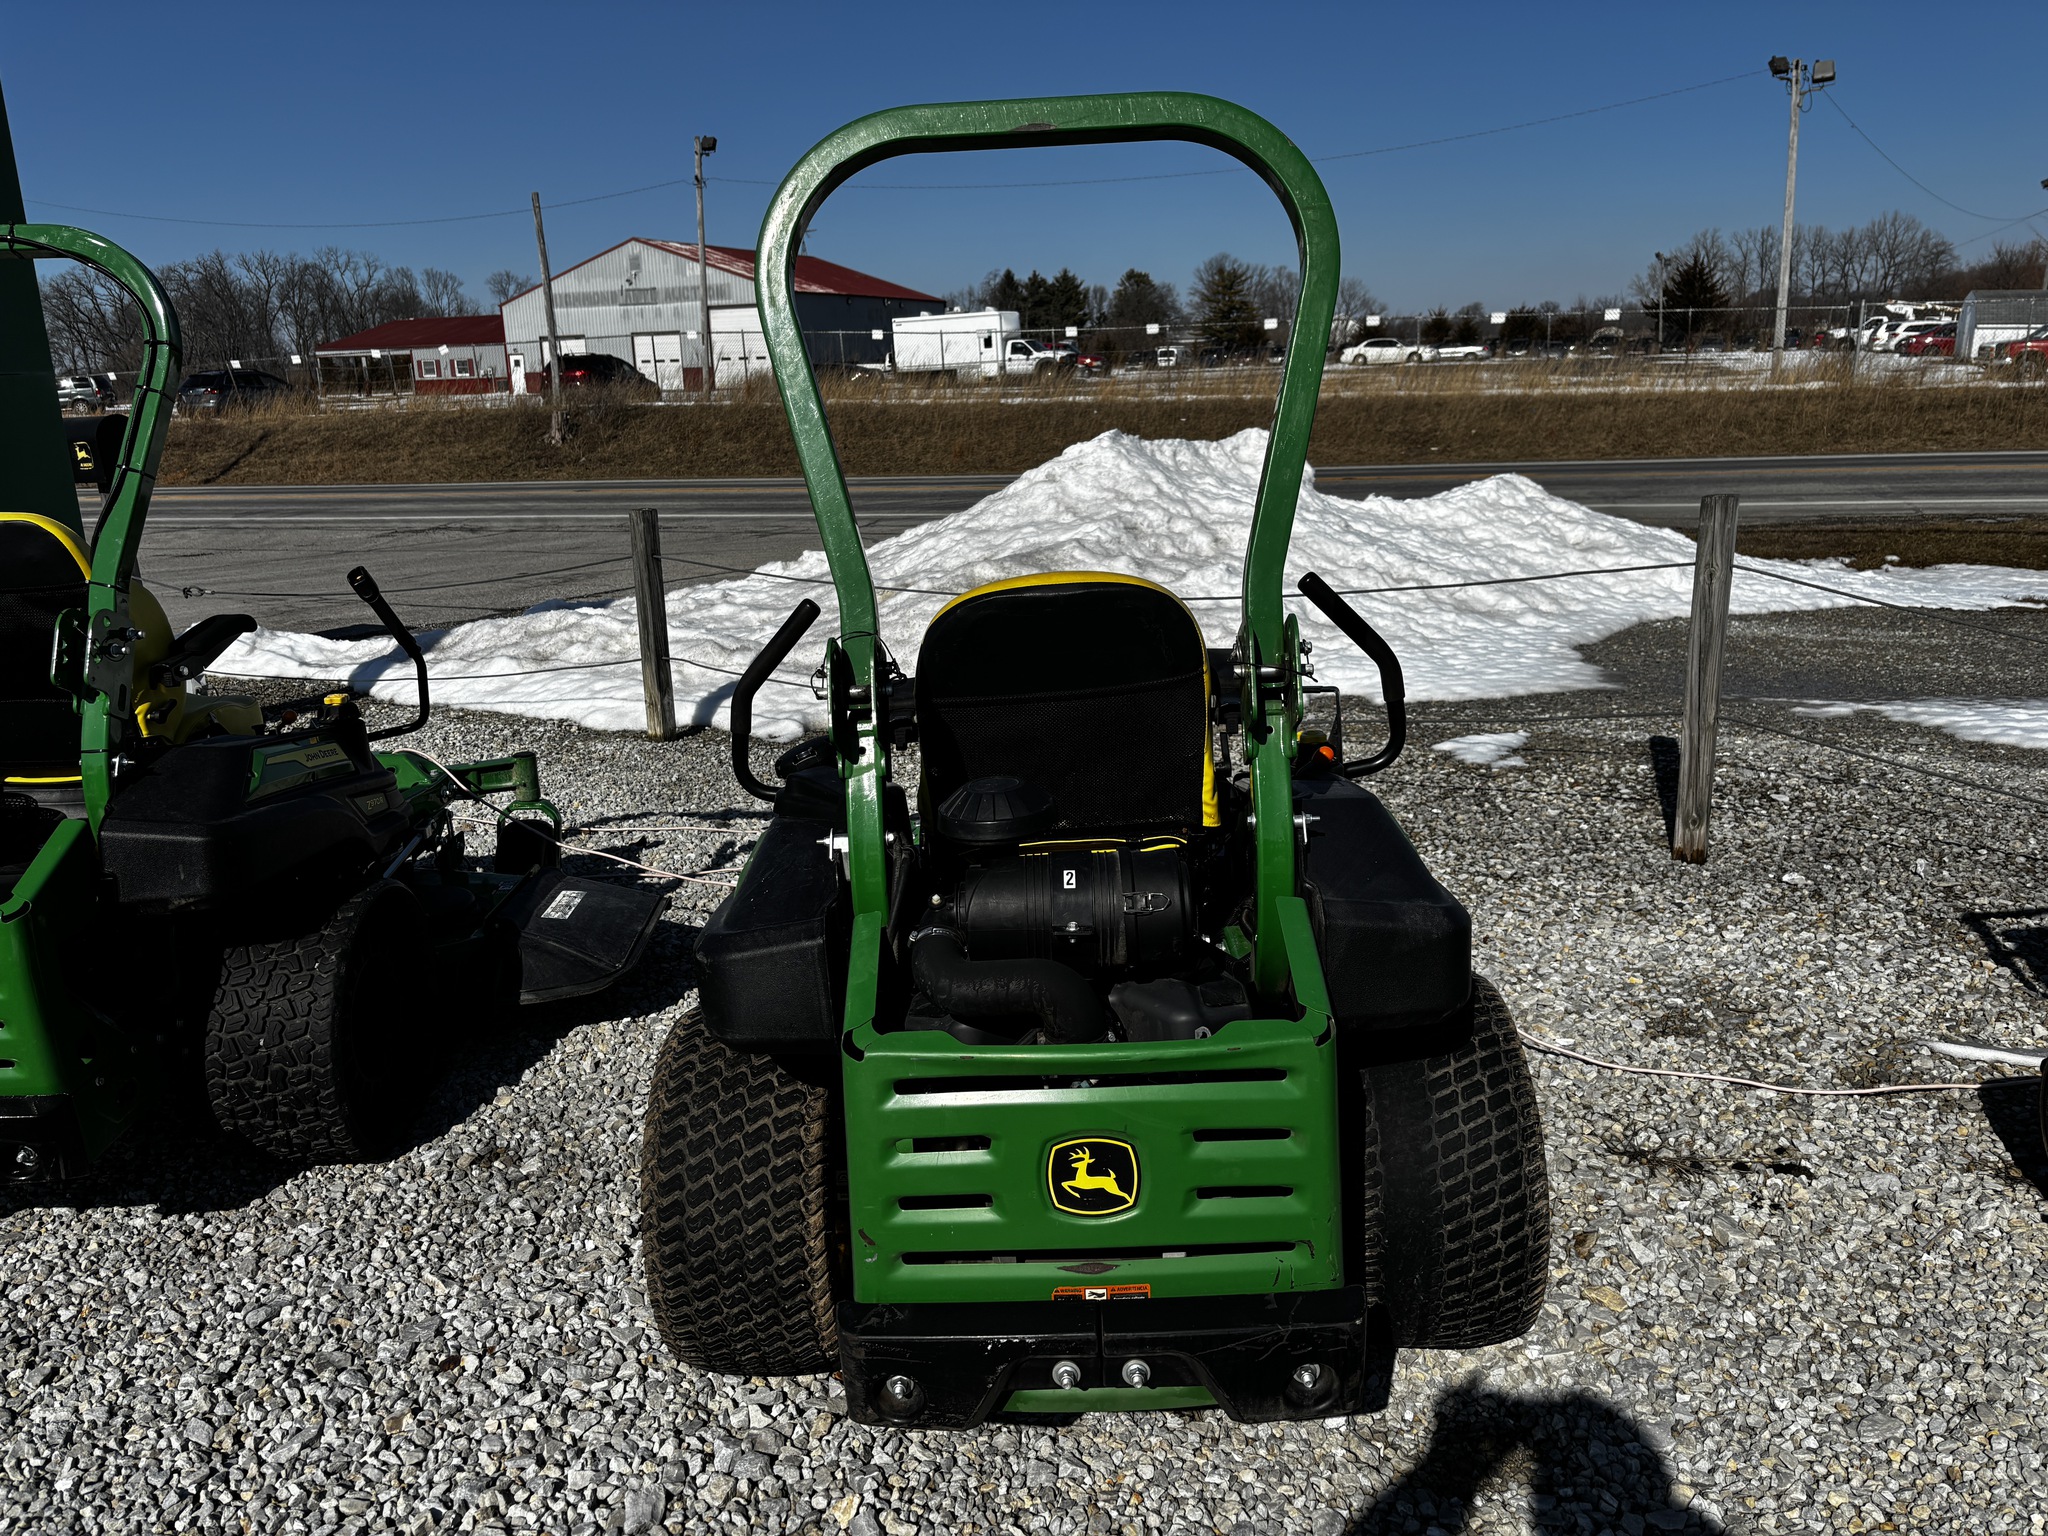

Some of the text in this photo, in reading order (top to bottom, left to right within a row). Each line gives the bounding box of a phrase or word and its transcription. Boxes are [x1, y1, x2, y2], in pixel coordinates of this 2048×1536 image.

[304, 748, 339, 762] JOHN DEERE
[1065, 871, 1074, 886] 2
